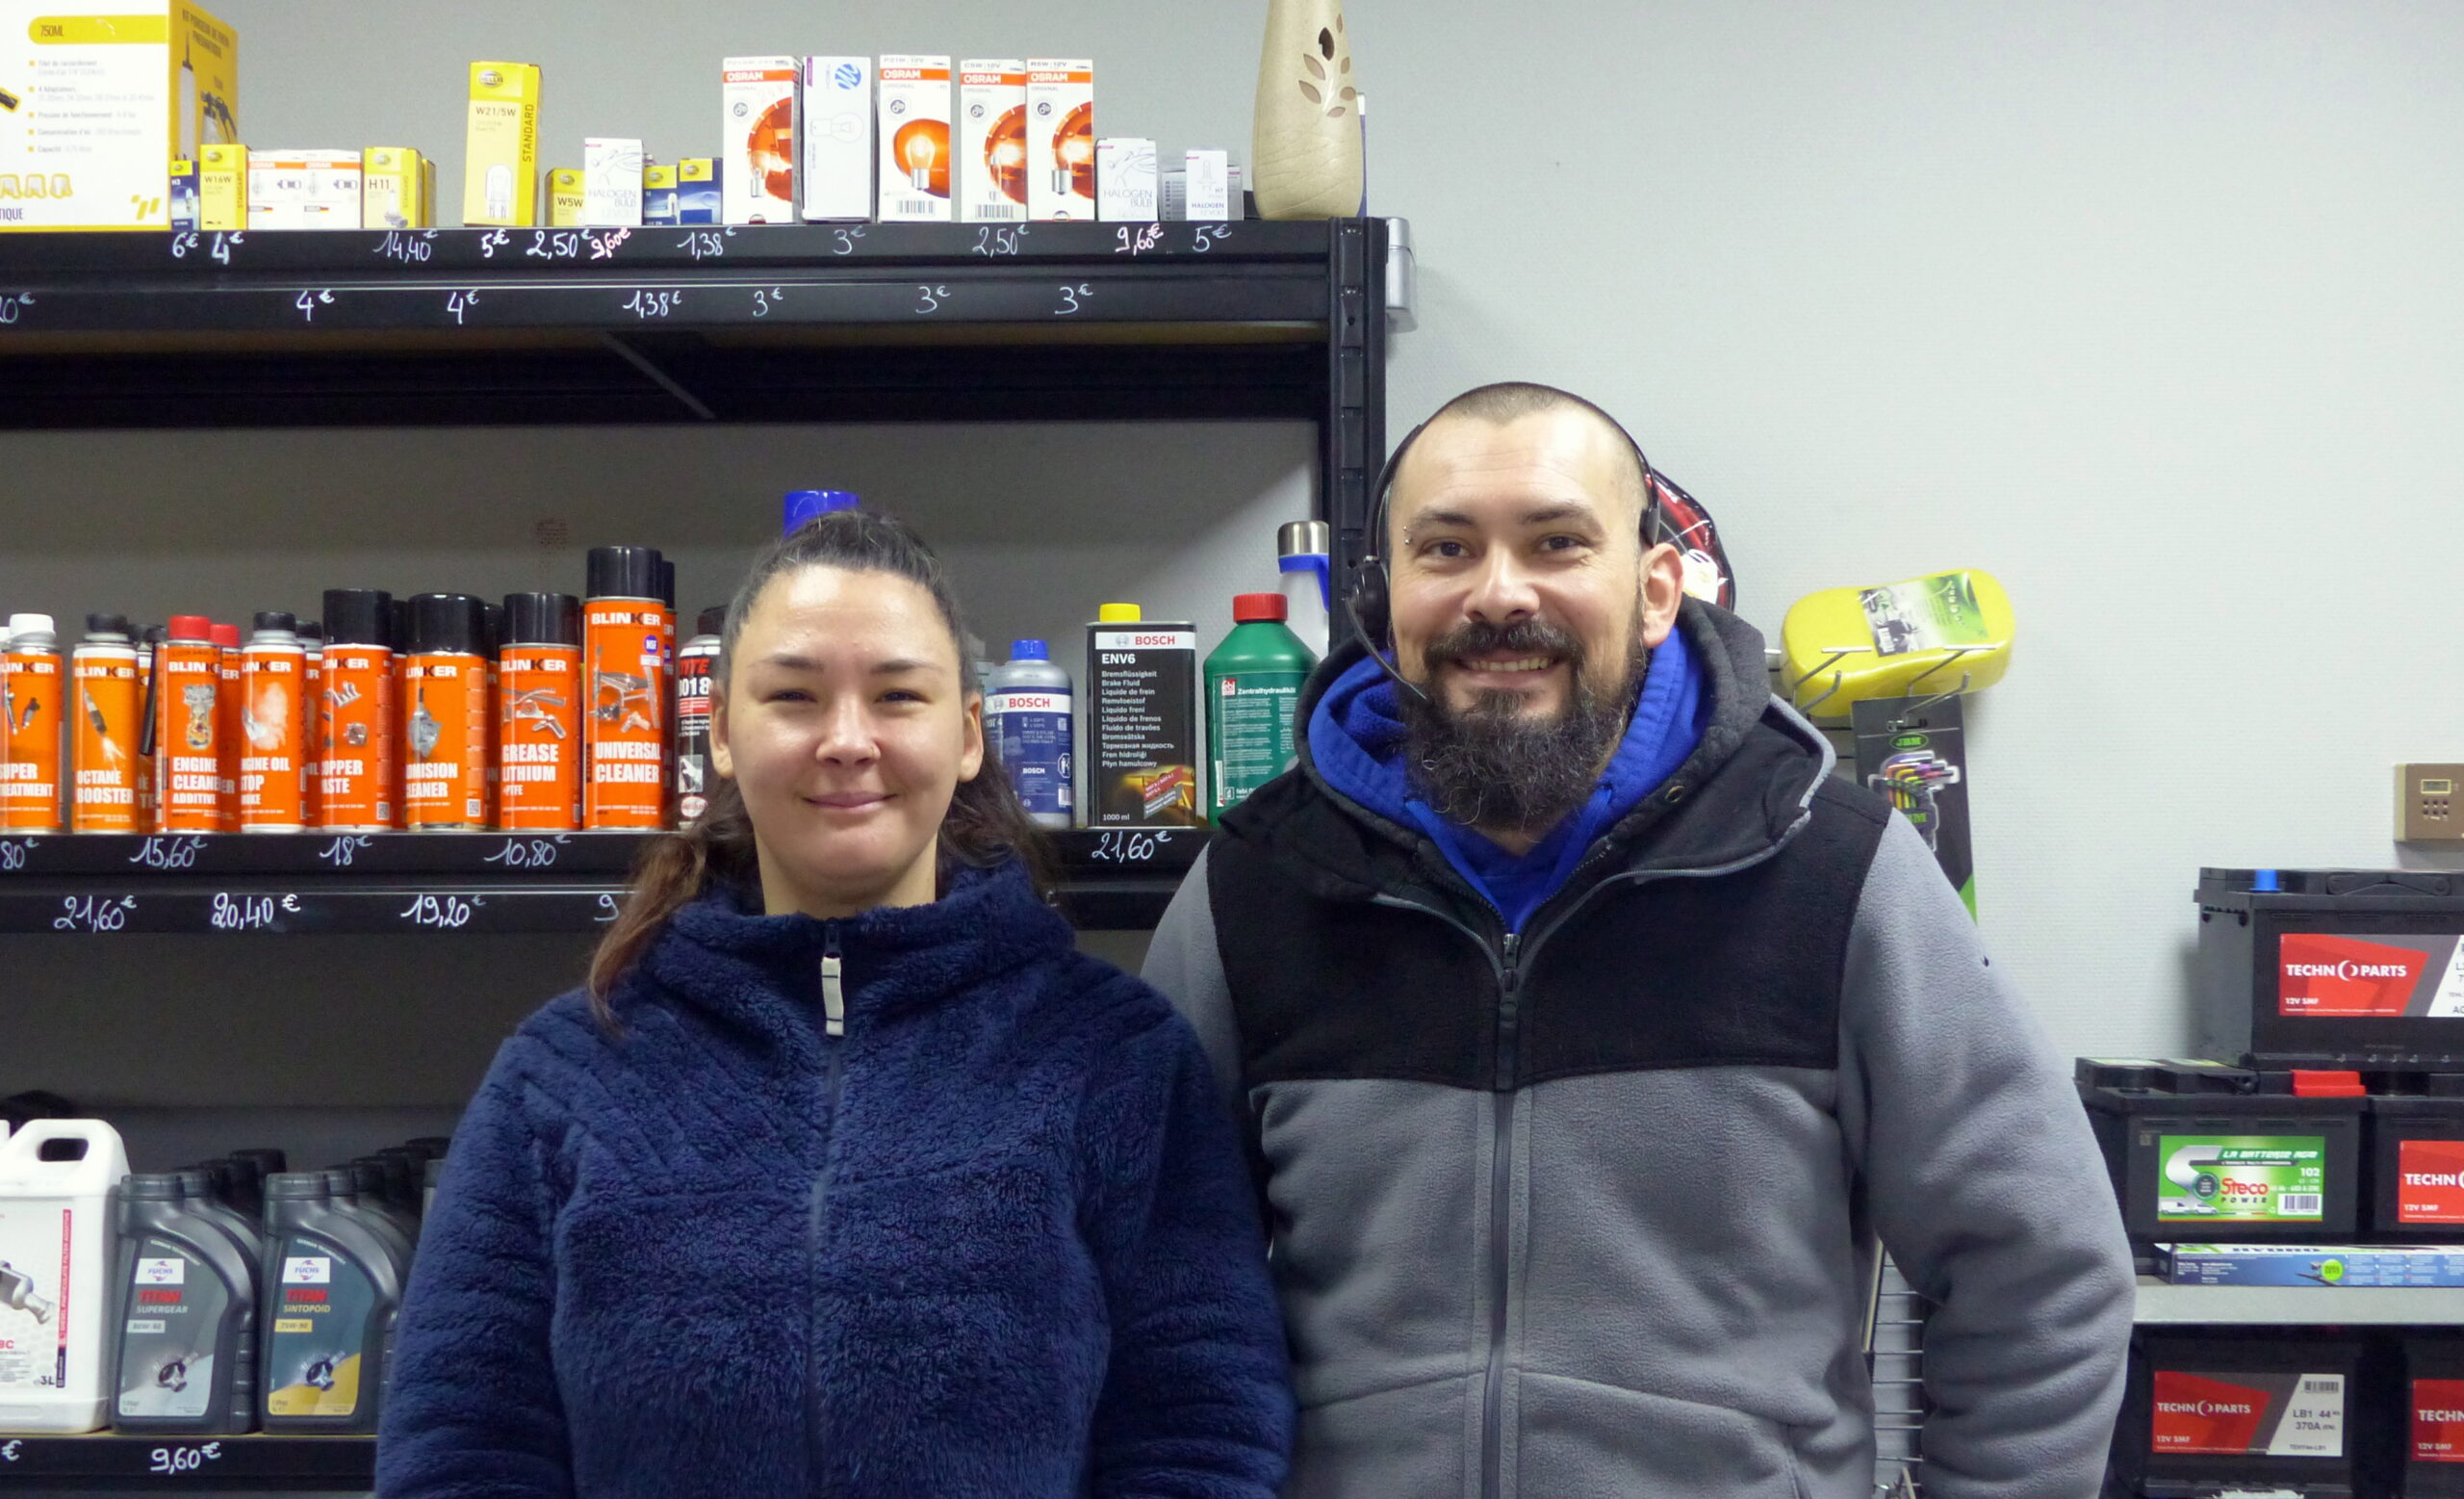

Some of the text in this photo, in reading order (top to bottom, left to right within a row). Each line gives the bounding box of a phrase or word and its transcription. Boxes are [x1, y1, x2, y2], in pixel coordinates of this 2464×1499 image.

[38, 25, 64, 38] 750ML
[726, 71, 764, 81] OSRAM
[884, 69, 921, 79] OSRAM
[963, 74, 1002, 84] OSRAM
[1030, 72, 1068, 82] OSRAM
[475, 106, 517, 117] W21/5W
[523, 103, 534, 163] STANDARD
[204, 175, 232, 184] W16W
[369, 178, 391, 190] H11
[557, 195, 584, 208] W5W
[588, 190, 637, 199] HALOGEN
[1103, 190, 1153, 199] HALOGEN
[614, 198, 637, 208] BULB
[1130, 198, 1153, 208] BULB
[171, 231, 199, 259] 6€
[481, 228, 510, 259] 5€
[834, 225, 867, 255] 3€
[1192, 222, 1233, 254] 5€
[211, 231, 245, 266] 4€
[295, 289, 336, 323] 4€
[753, 287, 784, 318] 3€
[913, 284, 951, 315] 3€
[1054, 283, 1094, 316] 3€
[447, 289, 480, 325] 4€
[592, 612, 661, 626] BLINKER
[1135, 635, 1175, 645] BOSCH
[1101, 653, 1136, 664] ENV6
[1009, 698, 1051, 709] BOSCH
[502, 743, 560, 763] GREASE
[595, 741, 662, 761] UNIVERSAL
[0, 762, 38, 780] UPER
[173, 757, 218, 773] ENGINE
[270, 757, 291, 771] OIL
[1022, 766, 1046, 775] BOSCH
[77, 769, 123, 786] OCTANE
[502, 765, 557, 782] LITHIUM
[595, 762, 660, 784] CLEANER
[77, 787, 135, 805] BOOSTER
[1120, 813, 1130, 821] ml
[2285, 996, 2301, 1006] 12V
[2299, 1167, 2321, 1177] 102
[2220, 1177, 2269, 1196] Steco
[139, 1289, 182, 1303] TITAN
[286, 1289, 328, 1303] TITAN
[136, 1305, 190, 1314] SUPERGEAR
[283, 1305, 331, 1313] SINTOPOID
